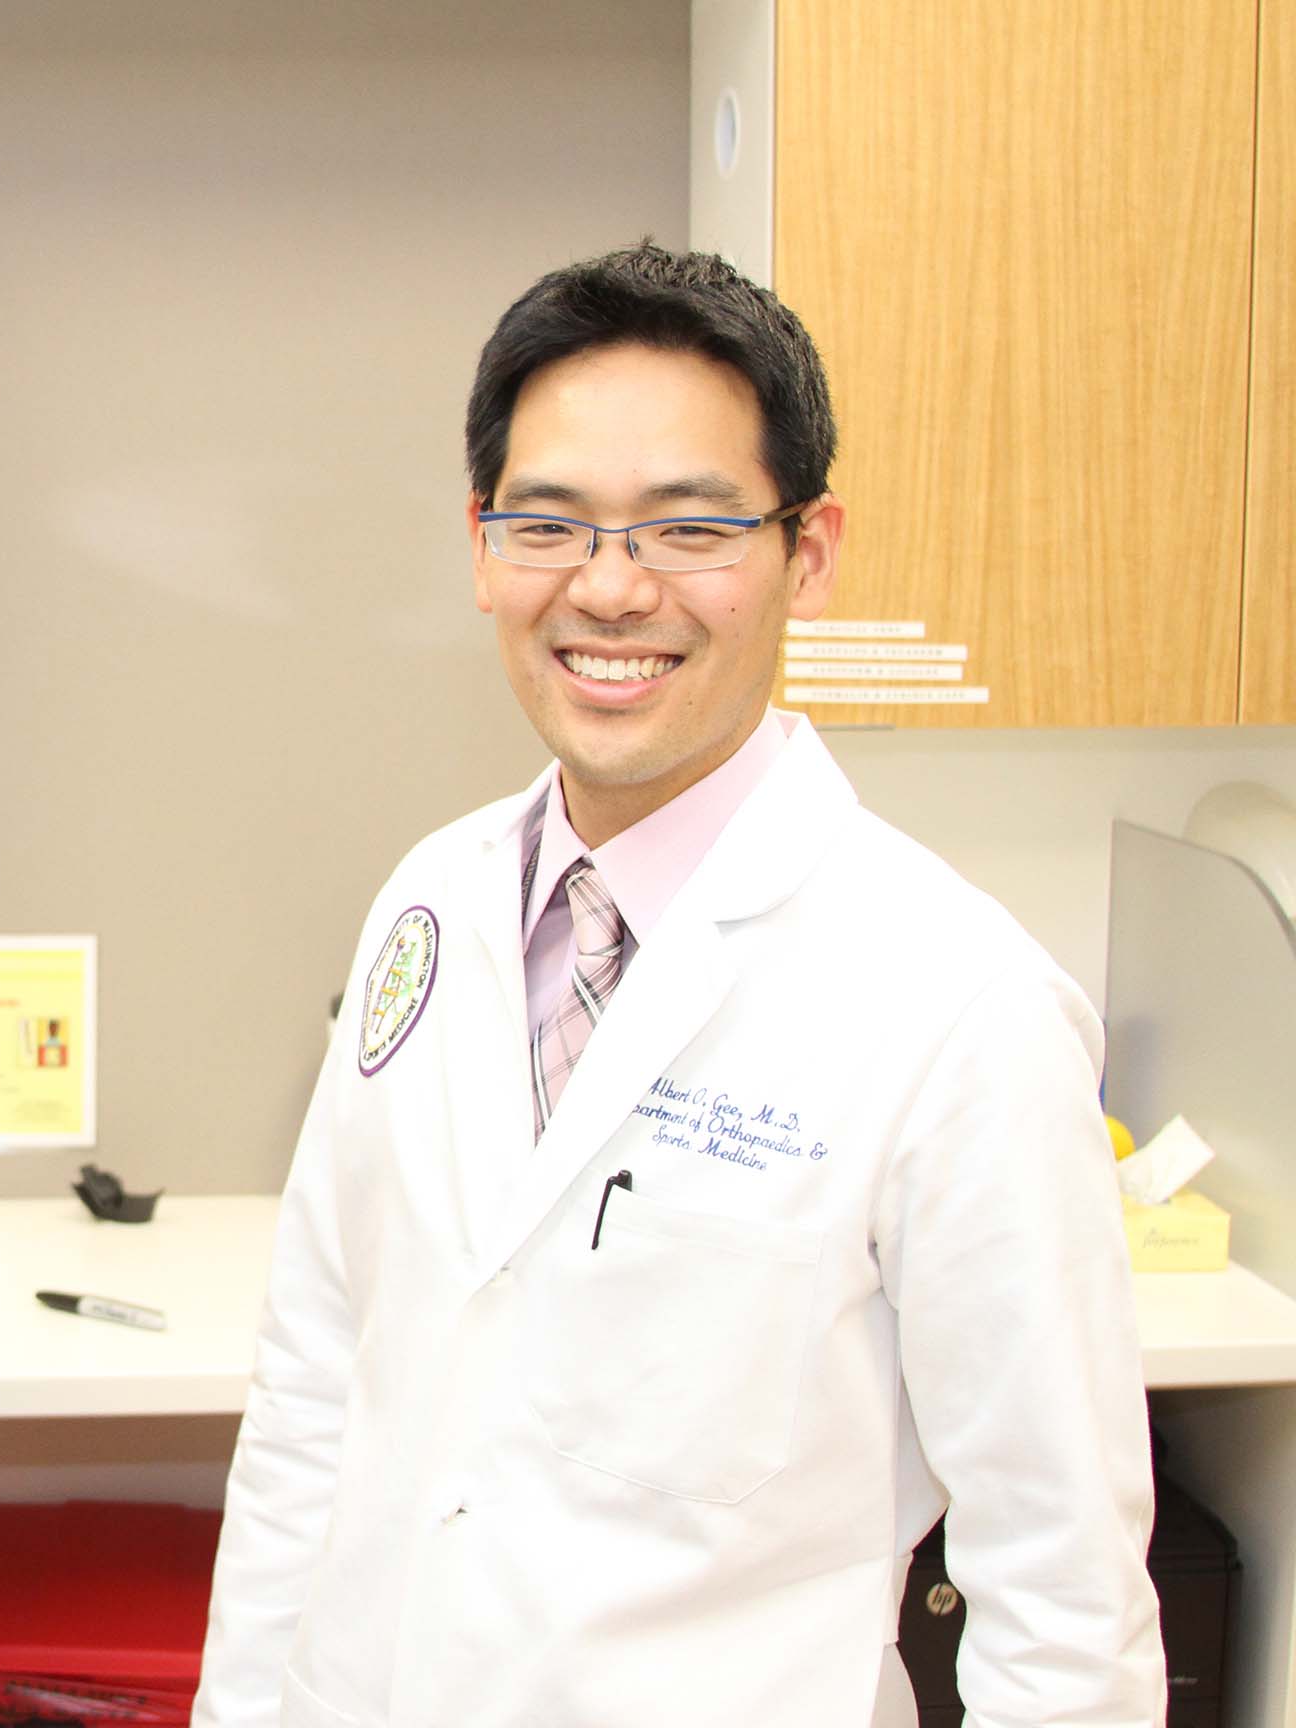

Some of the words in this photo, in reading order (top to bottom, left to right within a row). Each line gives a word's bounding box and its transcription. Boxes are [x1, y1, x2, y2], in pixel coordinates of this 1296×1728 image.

[417, 919, 434, 989] WASHINGTON
[387, 996, 418, 1042] MEDICINE
[648, 1077, 692, 1103] Albert
[710, 1094, 743, 1121] Gee,
[652, 1124, 691, 1150] Sports
[697, 1136, 768, 1172] Medicine
[689, 1111, 705, 1133] of
[707, 1115, 802, 1158] Orthopaedics
[809, 1142, 829, 1161] &
[930, 1584, 954, 1616] hp
